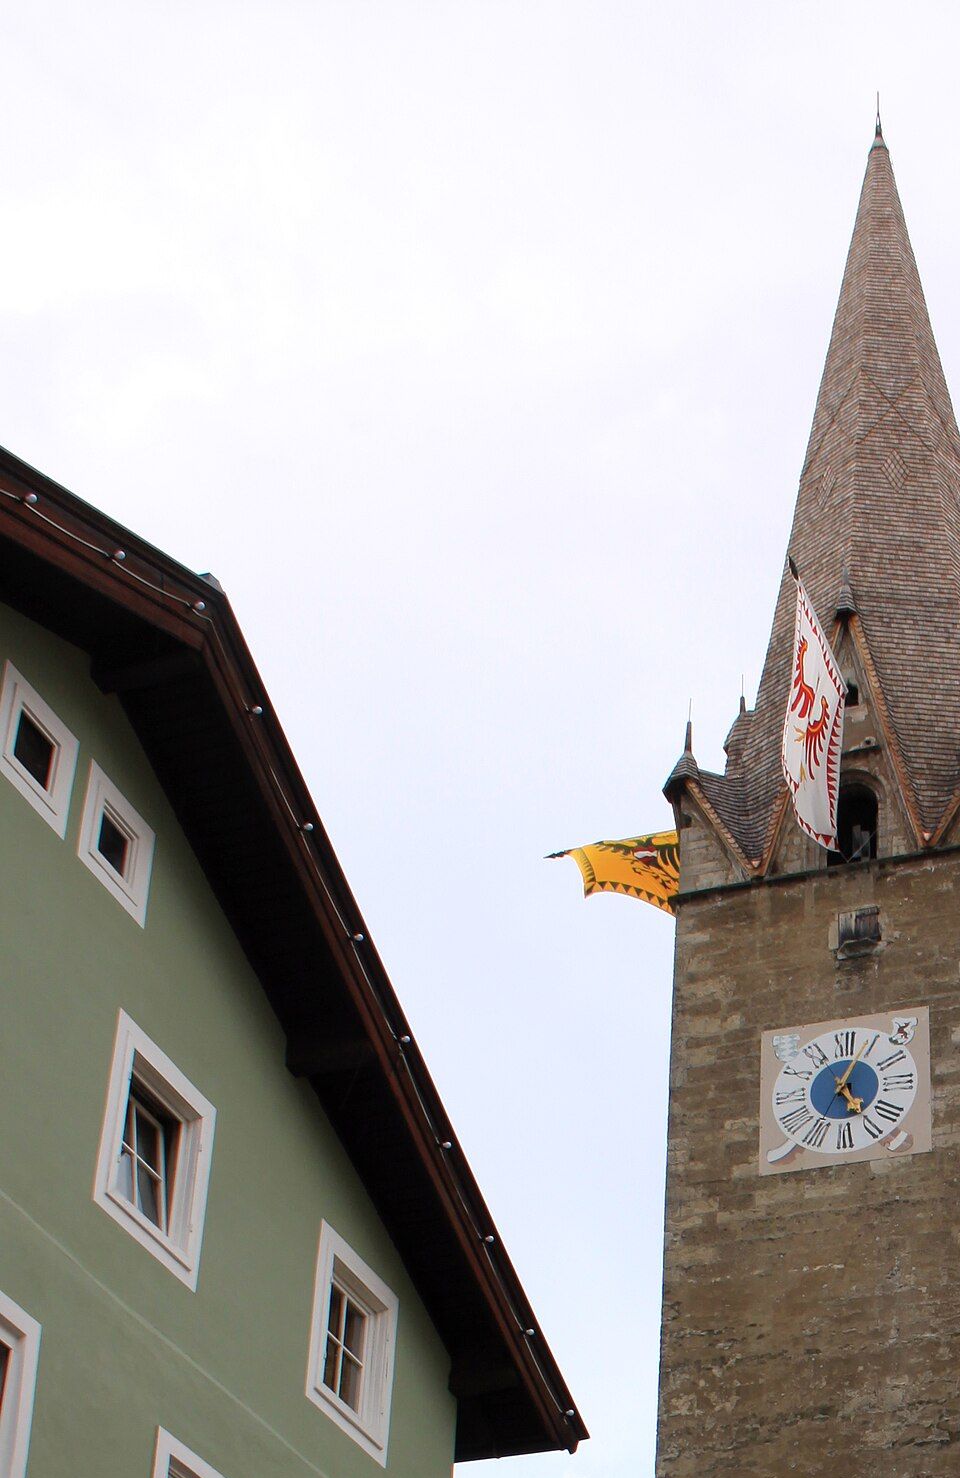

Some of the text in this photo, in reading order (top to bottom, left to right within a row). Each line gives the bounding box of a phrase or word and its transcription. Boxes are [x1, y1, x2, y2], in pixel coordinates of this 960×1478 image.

[834, 1030, 856, 1059] XII
[863, 1033, 880, 1059] I
[876, 1049, 907, 1072] II
[882, 1072, 914, 1093] III
